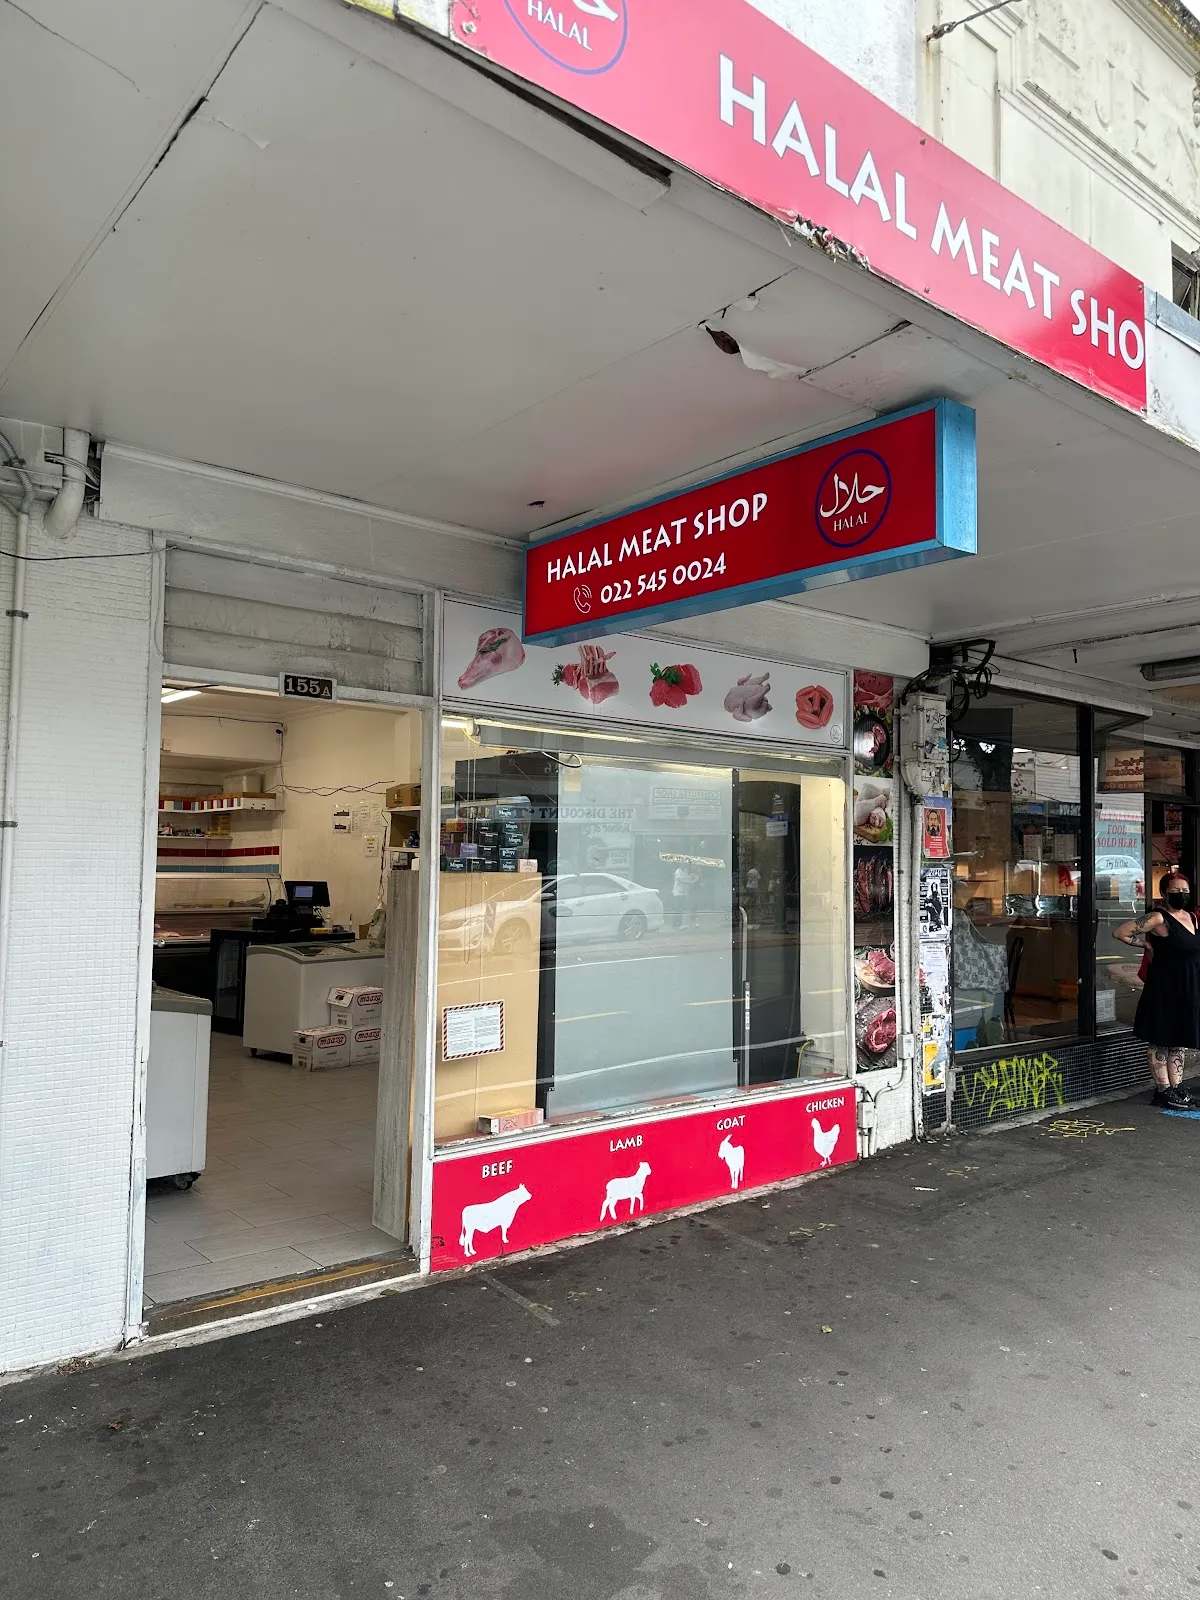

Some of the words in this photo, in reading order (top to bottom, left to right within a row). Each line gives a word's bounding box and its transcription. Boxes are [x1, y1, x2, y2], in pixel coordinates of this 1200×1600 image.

[527, 0, 593, 51] HALAL
[719, 54, 917, 241] HALAL
[930, 202, 1060, 319] MEAT
[1070, 289, 1145, 369] SHO
[819, 472, 886, 518] حلال
[833, 511, 869, 532] HALAL
[547, 542, 613, 584] HALAL
[618, 517, 687, 562] MEAT
[693, 492, 768, 540] SHOP
[600, 579, 632, 605] 022
[637, 568, 668, 597] 545
[672, 552, 727, 587] 0024
[319, 1036, 345, 1047] maaza
[805, 1096, 846, 1113] CHICKEN
[716, 1114, 746, 1131] GOAT
[609, 1135, 643, 1152] LAMB
[482, 1160, 513, 1179] BEEF
